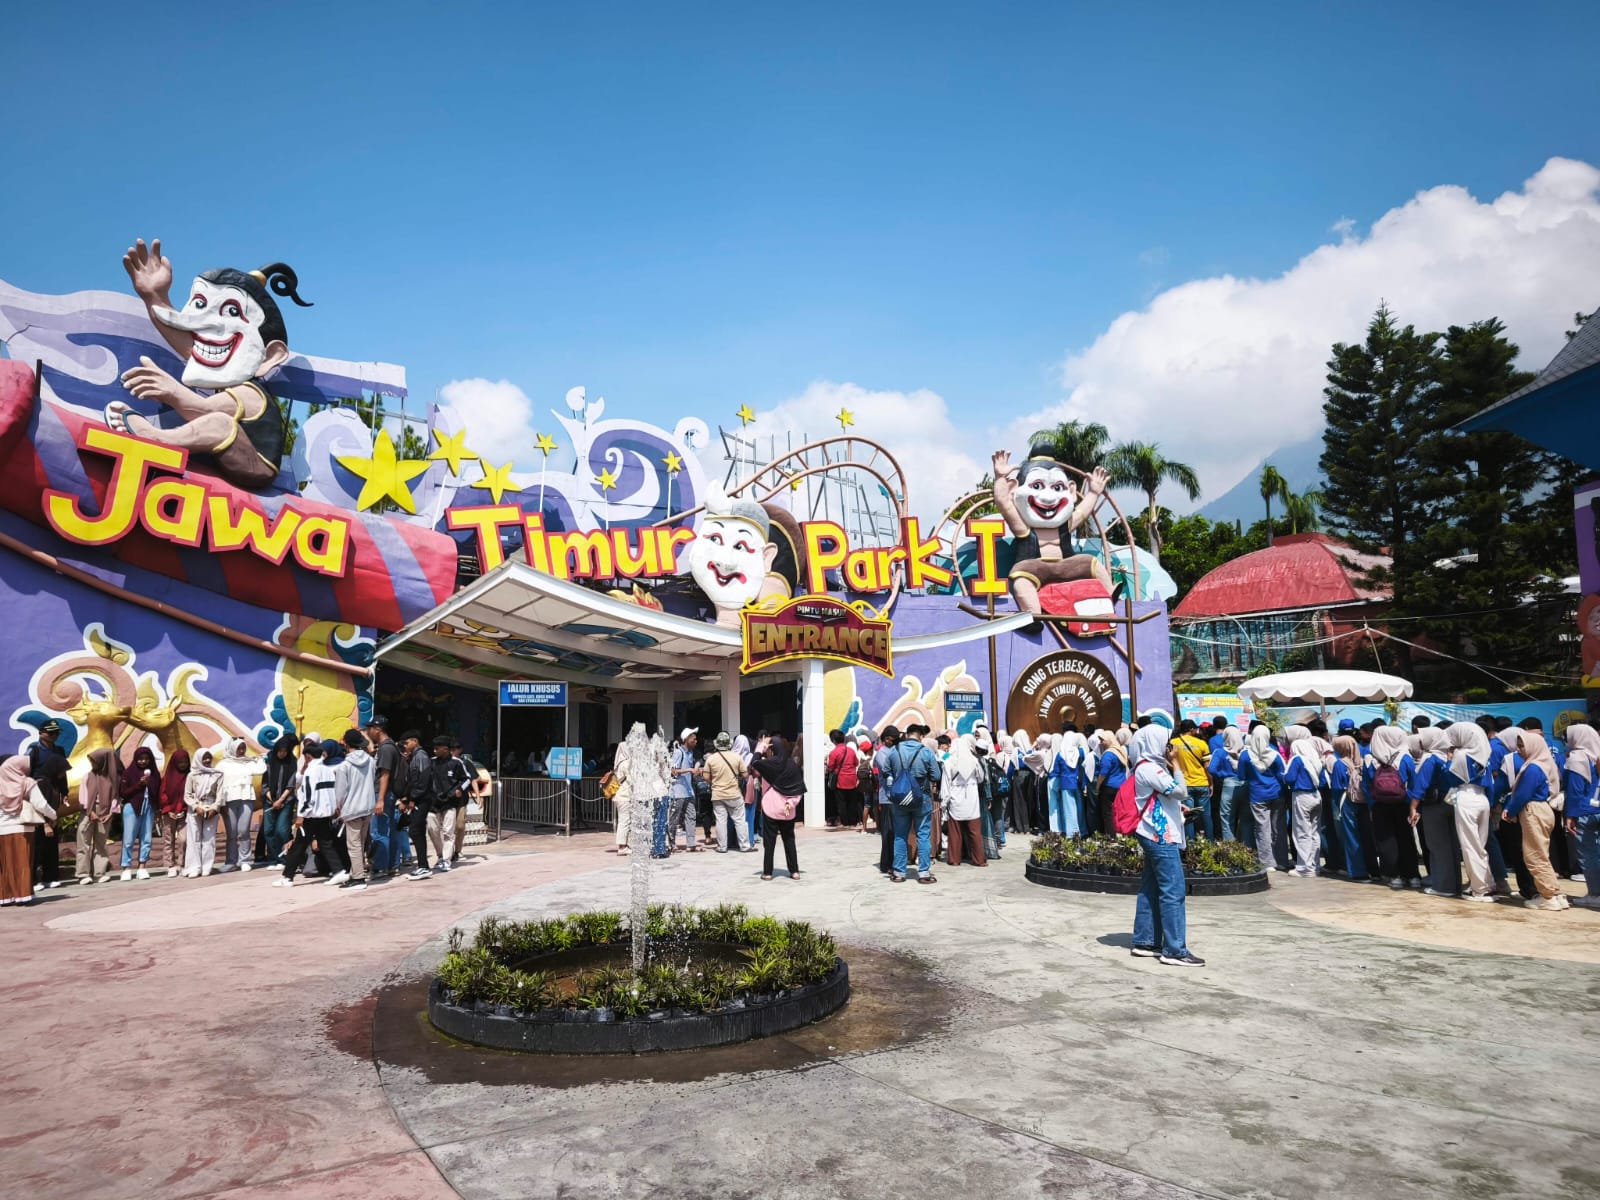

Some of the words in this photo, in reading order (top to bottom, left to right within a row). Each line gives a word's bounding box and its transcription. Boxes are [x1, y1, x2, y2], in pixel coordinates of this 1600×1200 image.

[42, 423, 350, 576] Jawa
[445, 503, 696, 581] Timur
[801, 517, 953, 594] Park
[965, 519, 1009, 596] I
[797, 605, 820, 615] PINTU
[751, 623, 888, 659] ENTRANCE
[508, 683, 530, 693] JALUR
[530, 684, 561, 694] KHUSUS
[1022, 668, 1047, 696] GONG
[1044, 660, 1097, 681] TERBESAR
[1093, 674, 1109, 693] KE
[1039, 695, 1055, 719] JAWA
[1051, 684, 1077, 697] TIMUR
[1077, 687, 1096, 711] PARK
